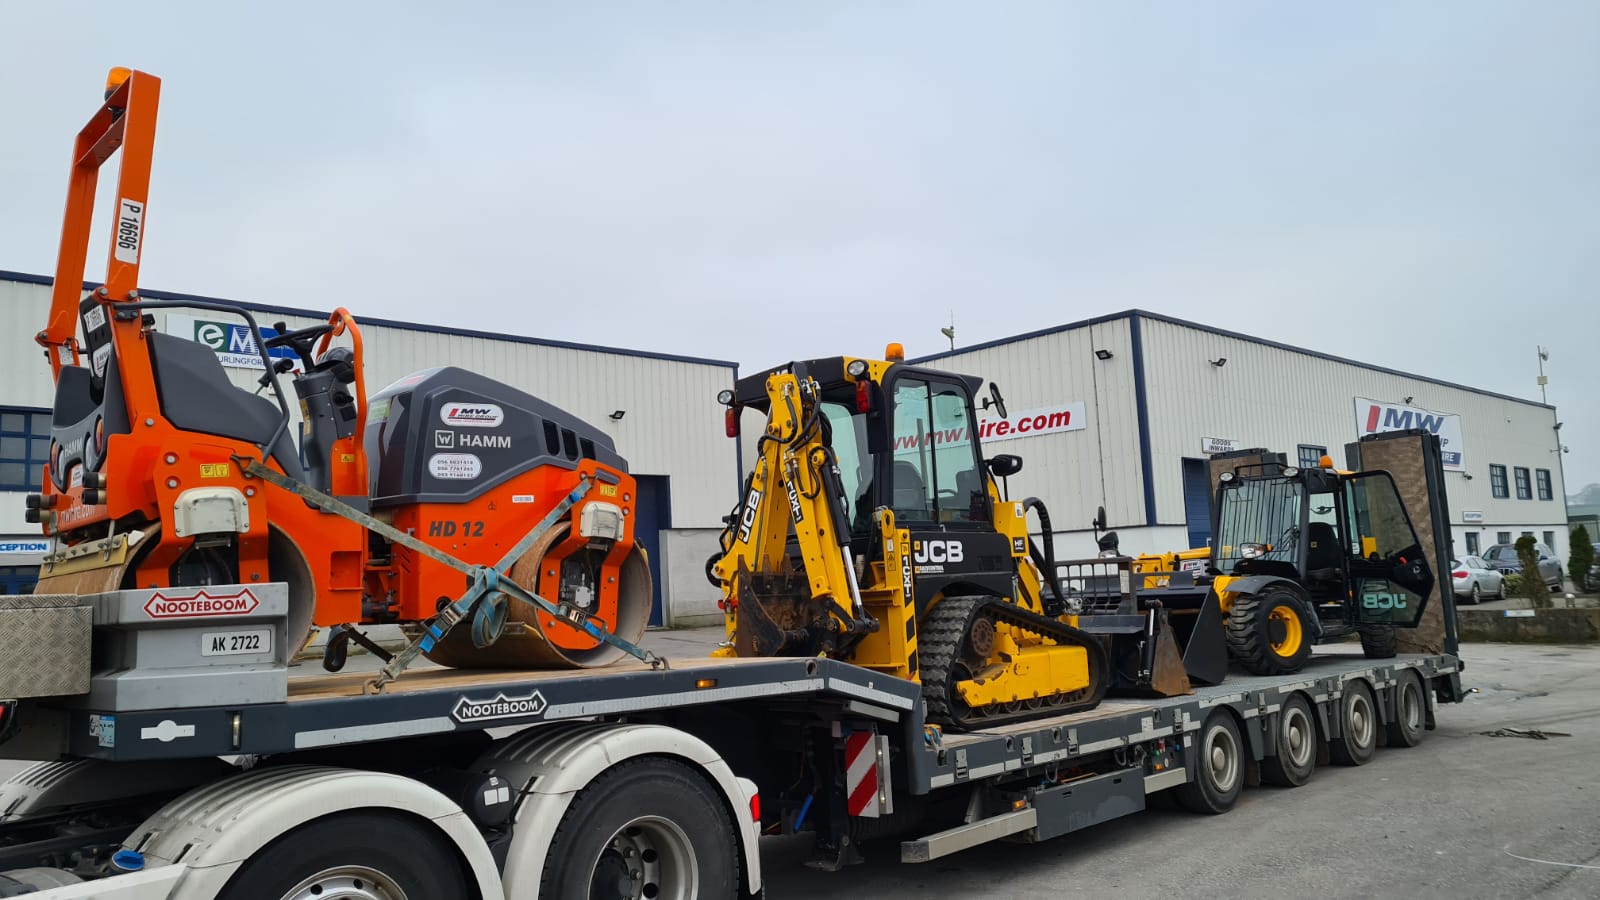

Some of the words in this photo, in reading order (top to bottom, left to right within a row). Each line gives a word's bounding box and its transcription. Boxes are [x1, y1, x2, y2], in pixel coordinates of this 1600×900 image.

[123, 203, 141, 213] P
[118, 216, 139, 250] 16696
[460, 433, 511, 449] HAMM
[740, 491, 760, 542] JCB
[429, 521, 456, 537] HD
[462, 521, 484, 537] 12
[914, 540, 964, 562] JCB
[155, 599, 248, 613] NOOTEBOOM
[211, 636, 226, 652] AK
[230, 634, 260, 649] 2722
[463, 702, 538, 718] NOOTEBOOM
